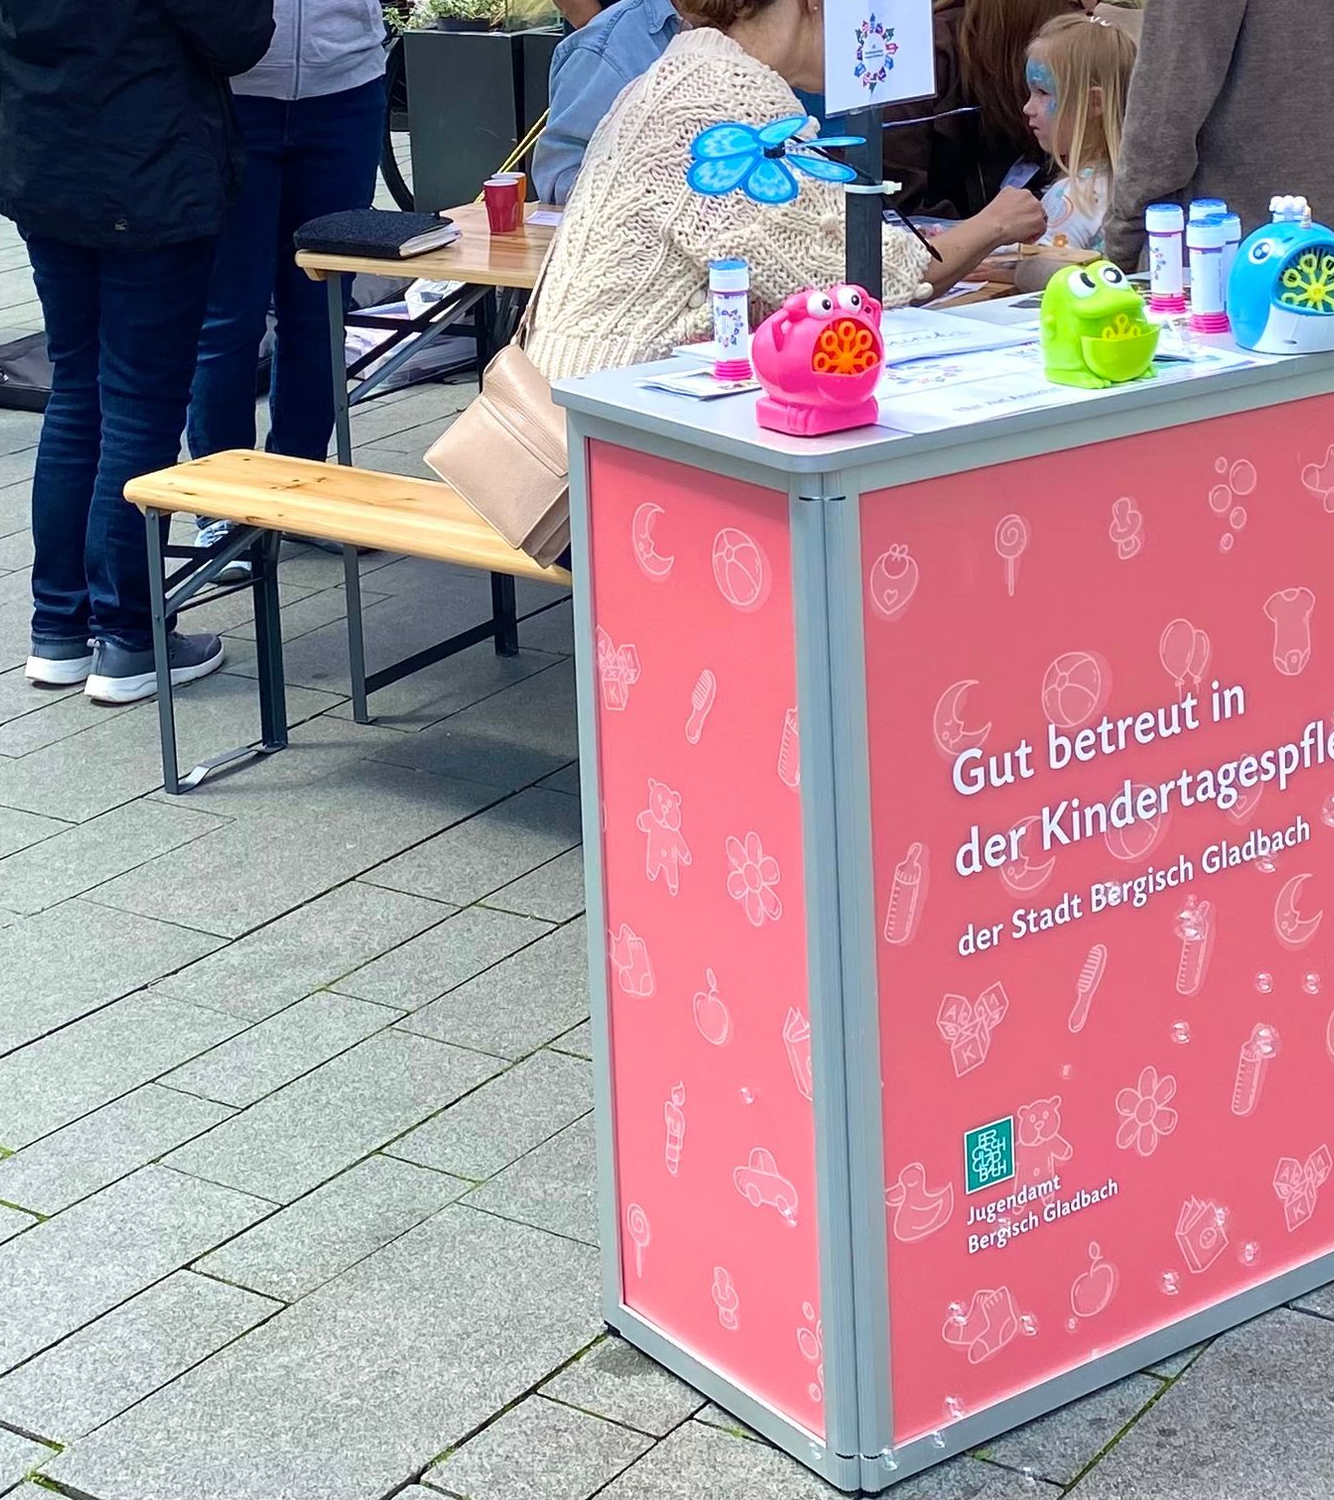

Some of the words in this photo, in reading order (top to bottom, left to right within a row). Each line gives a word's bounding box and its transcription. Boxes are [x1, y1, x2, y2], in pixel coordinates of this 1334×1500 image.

[952, 738, 1035, 796] Gut
[1049, 693, 1200, 768] betreut
[1211, 680, 1246, 722] in
[955, 825, 1027, 876] der
[958, 916, 1003, 956] der
[1011, 897, 1083, 939] Stadt
[1090, 857, 1194, 913] Bergisch
[1201, 816, 1311, 875] Gladbach
[967, 1174, 1061, 1225] Jugendamt
[968, 1211, 1039, 1254] Bergisch
[1043, 1178, 1118, 1223] Gladbach
